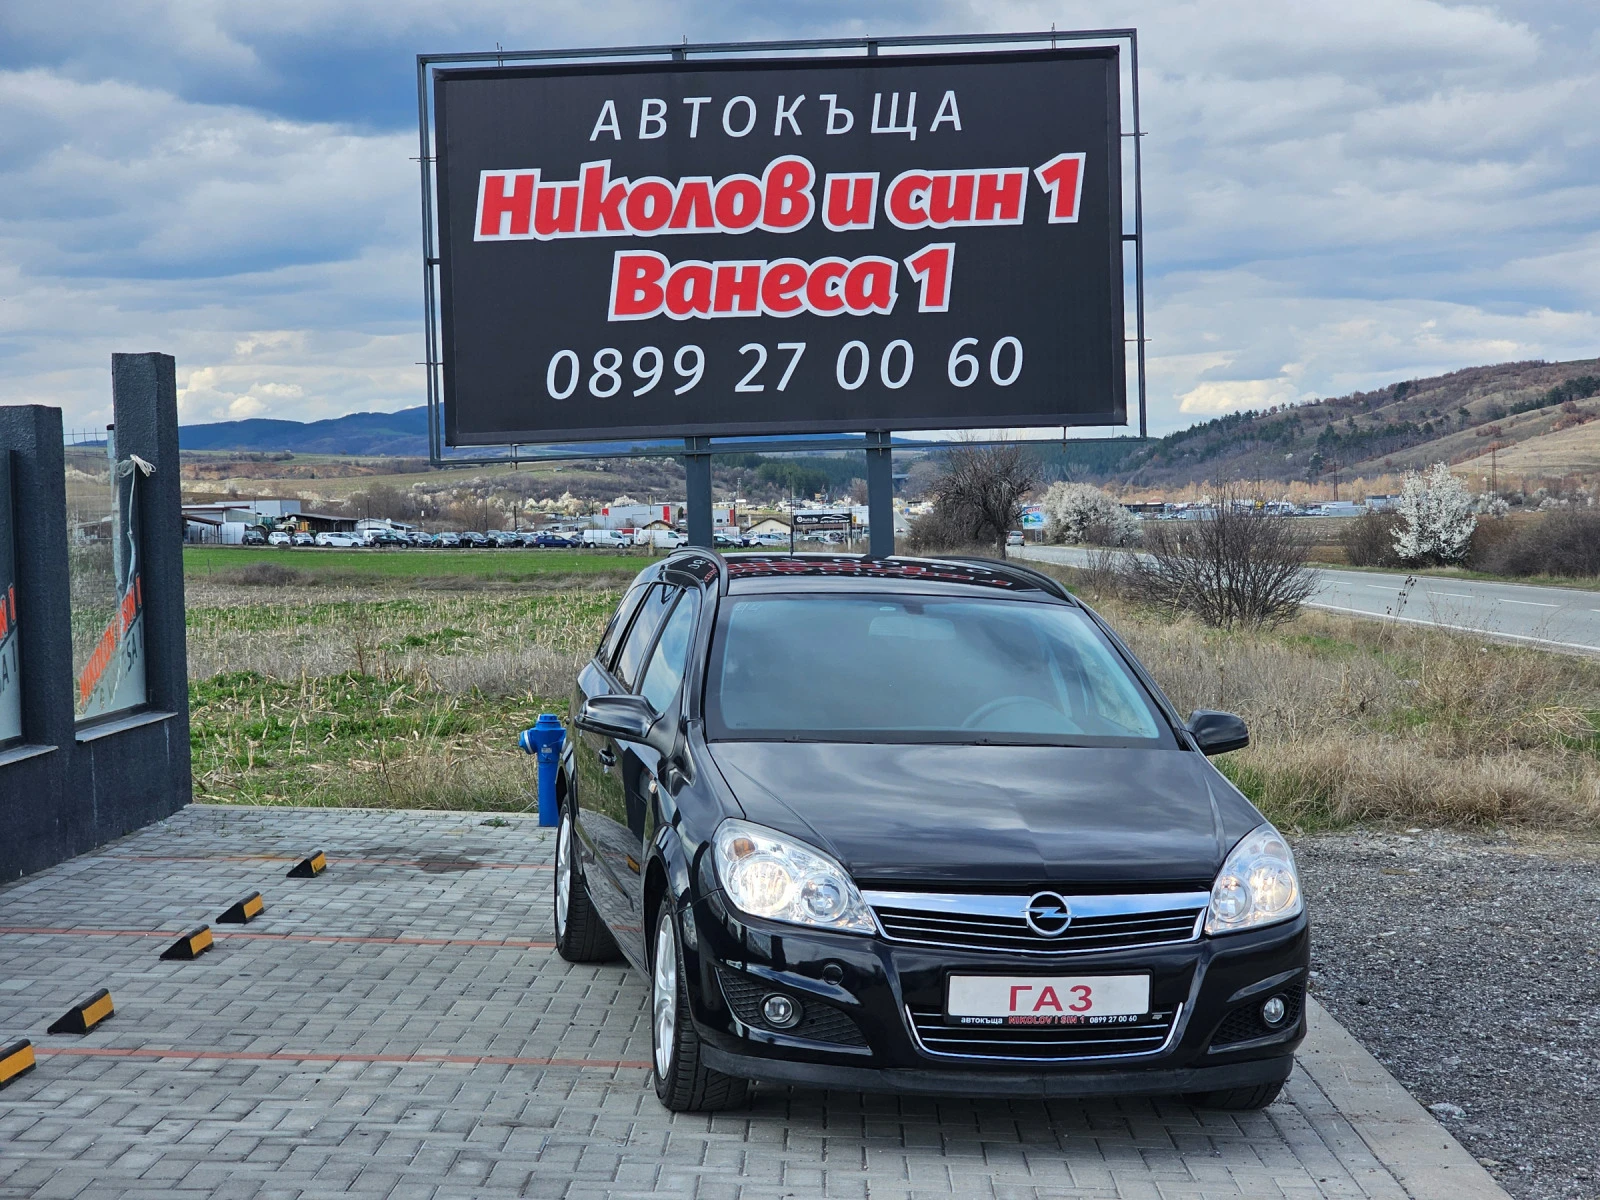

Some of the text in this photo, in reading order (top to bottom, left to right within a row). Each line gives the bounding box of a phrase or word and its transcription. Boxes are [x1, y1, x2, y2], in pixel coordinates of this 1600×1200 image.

[590, 90, 962, 142] АВТОКЪЩА
[473, 152, 1086, 242] Николов и син 1
[607, 242, 956, 321] Ванеса 1
[547, 336, 1024, 401] 0899 27 00 60
[961, 1017, 1003, 1025] автокъща
[1008, 1015, 1052, 1025] NIKOLOV
[1060, 1015, 1077, 1024] SIN
[1080, 1014, 1085, 1024] 1
[1089, 1016, 1107, 1024] 0899
[1108, 1016, 1117, 1024] 27
[1118, 1015, 1127, 1023] 00
[1128, 1014, 1137, 1022] 60
[1009, 985, 1093, 1012] ГАЗ
